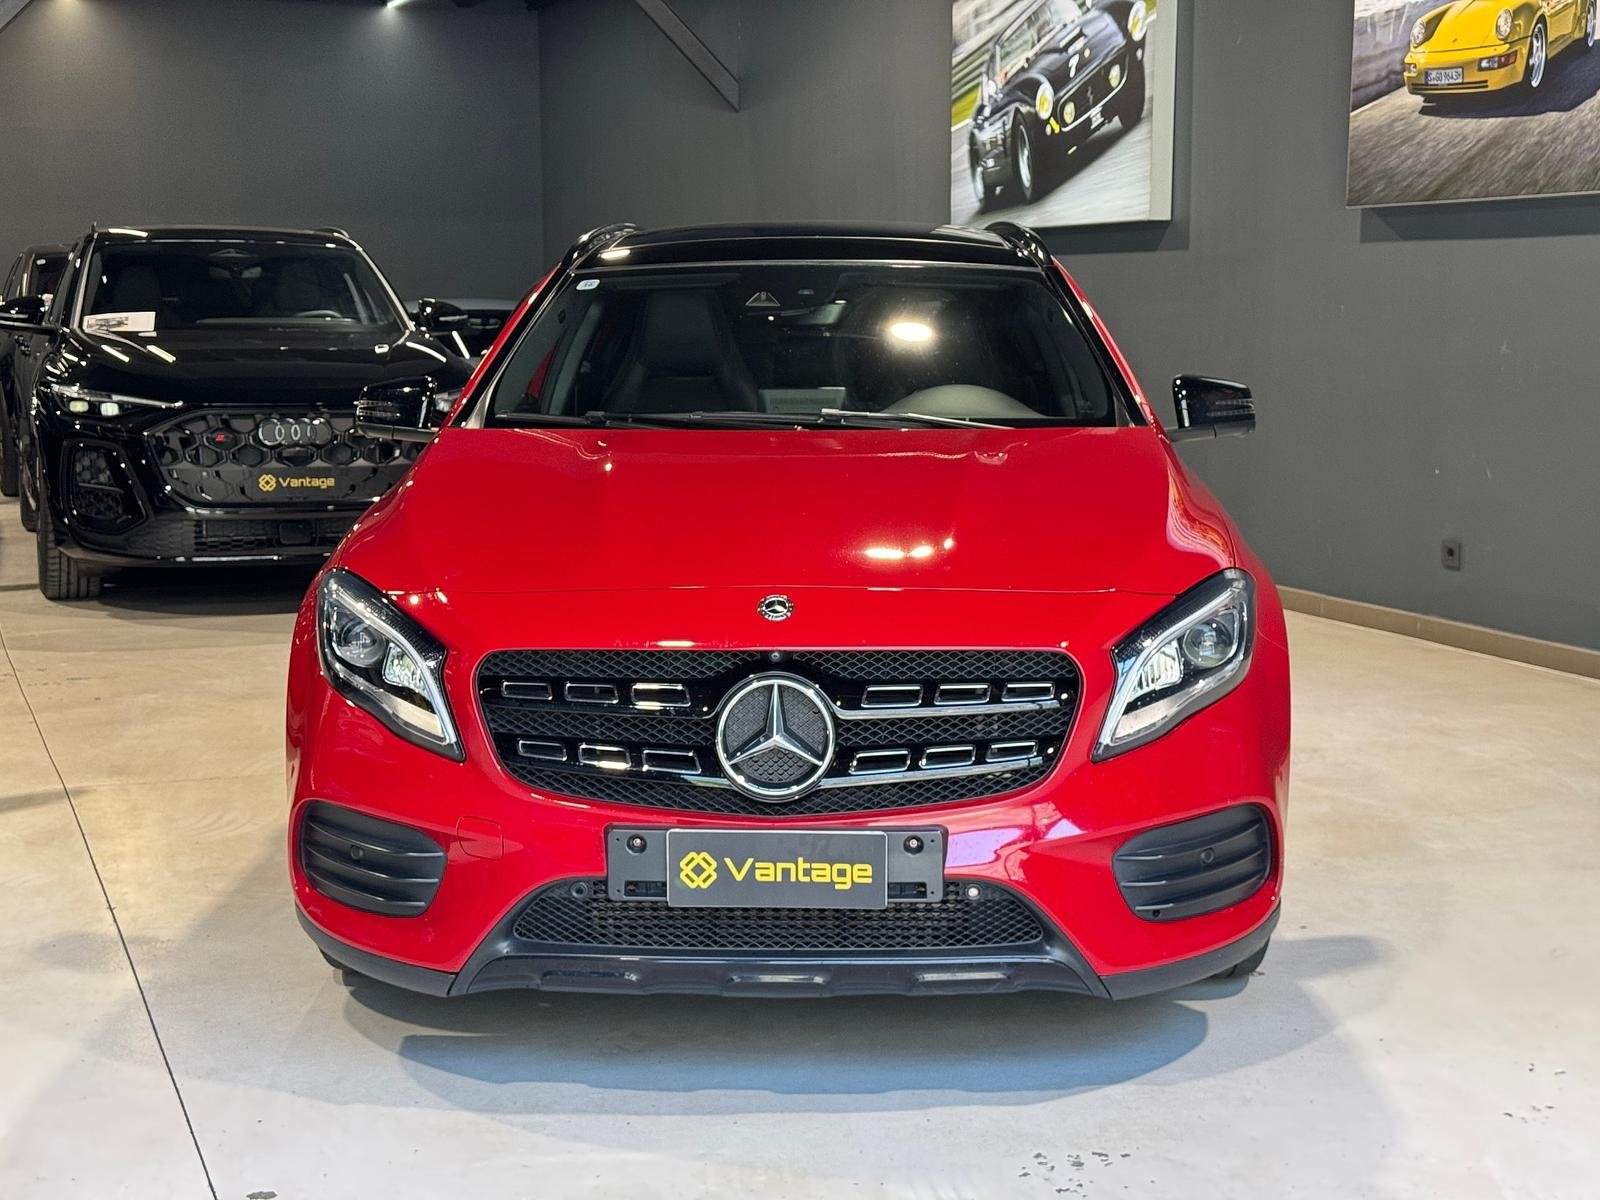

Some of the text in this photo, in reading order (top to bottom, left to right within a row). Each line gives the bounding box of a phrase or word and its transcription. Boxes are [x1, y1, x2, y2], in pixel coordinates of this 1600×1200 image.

[1068, 53, 1080, 78] 7
[279, 476, 335, 489] Vantage
[724, 857, 873, 890] Vantage
